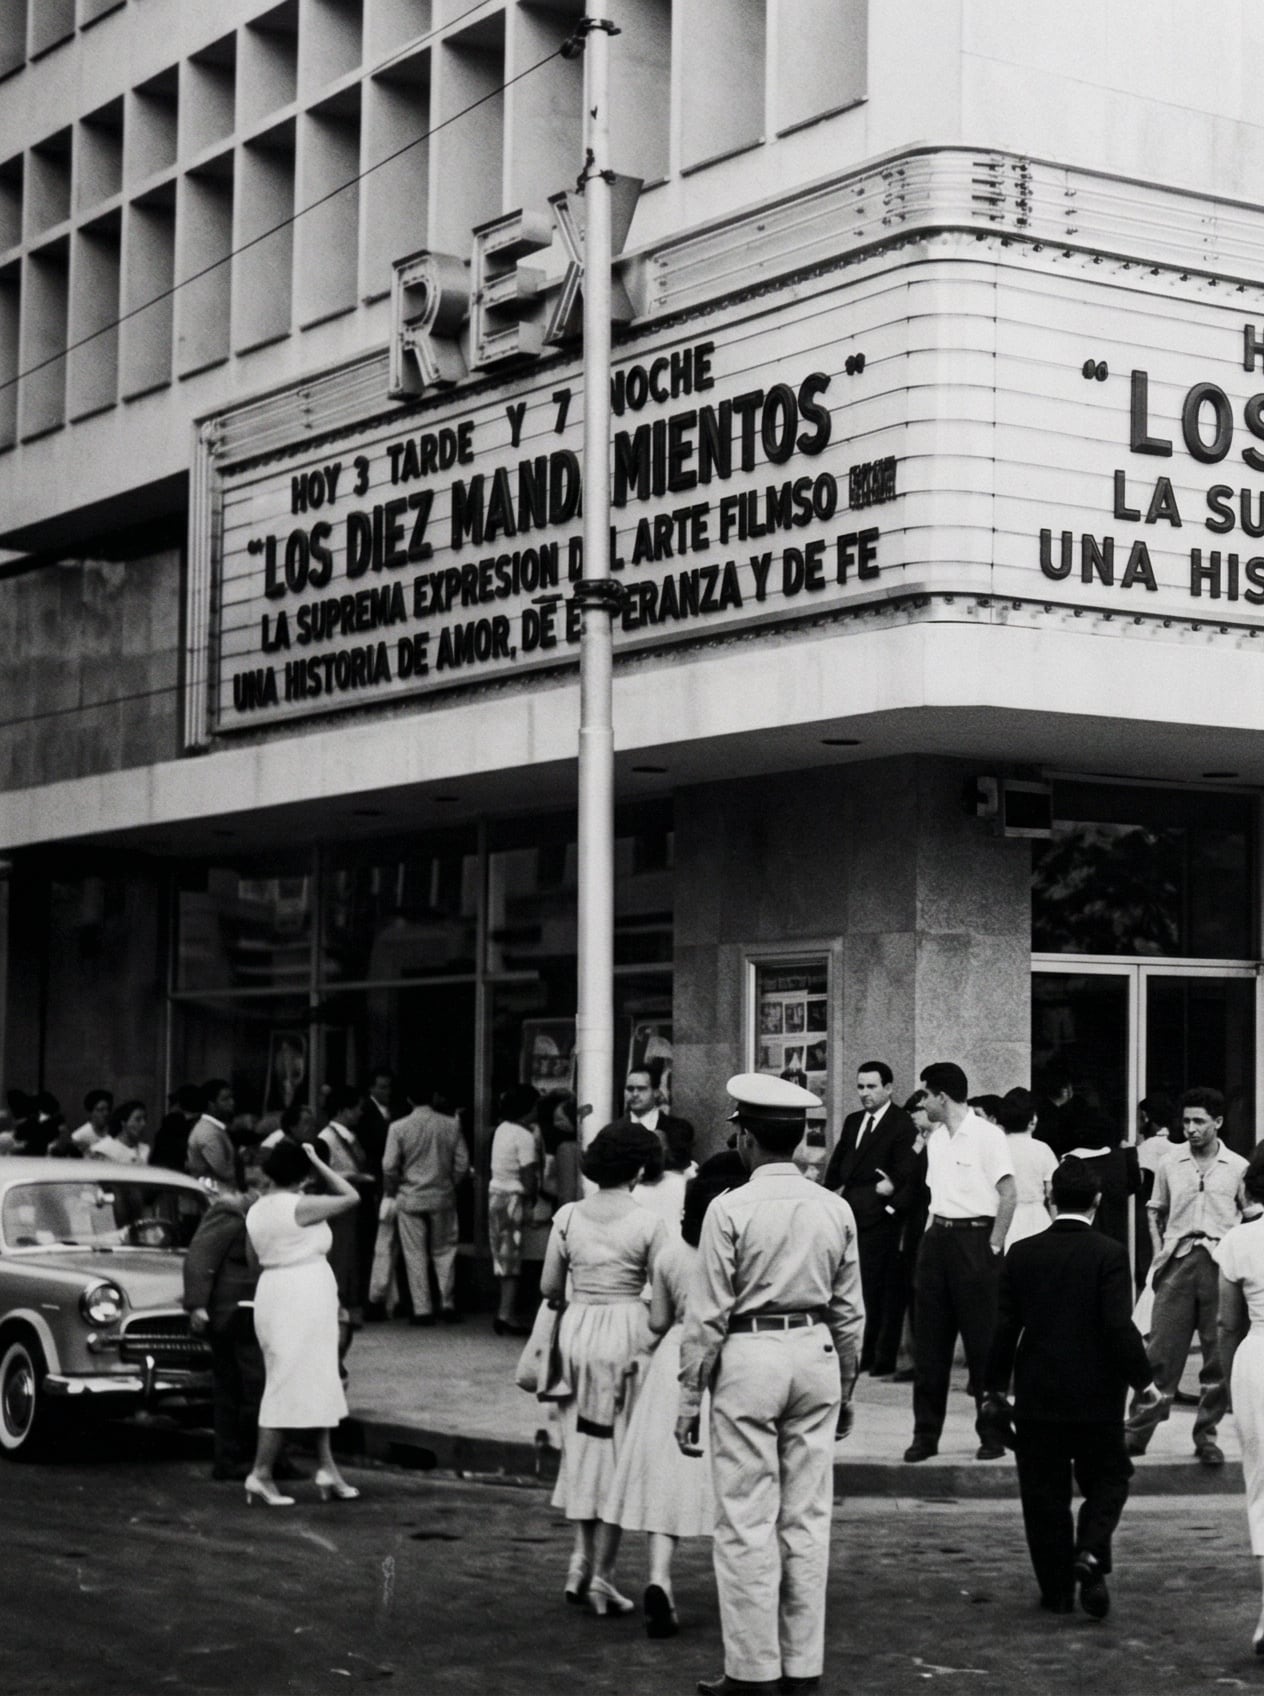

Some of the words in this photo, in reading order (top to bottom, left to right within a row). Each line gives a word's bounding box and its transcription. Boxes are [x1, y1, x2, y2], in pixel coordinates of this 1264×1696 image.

[388, 171, 644, 400] REX
[290, 461, 342, 515] HOY
[353, 455, 370, 497] 3
[386, 419, 475, 486] TARDE
[505, 402, 527, 449] Y
[552, 388, 572, 435] 7
[1113, 469, 1183, 528] LA
[260, 610, 291, 654] LA
[296, 581, 408, 646] SUPREMA
[412, 541, 560, 619] EXPRESION
[568, 525, 625, 583] DL
[631, 502, 711, 567] ARTE
[719, 471, 839, 545] FILMSO
[345, 488, 434, 580] DIEZ
[1038, 528, 1159, 592] UNA
[232, 665, 278, 712] UNA
[284, 641, 392, 702] HISTORIA
[397, 631, 430, 680] DE
[436, 614, 517, 671] AMOR,
[521, 594, 558, 652] DE
[750, 551, 772, 602] Y
[782, 539, 826, 597] DE
[836, 526, 882, 585] FE
